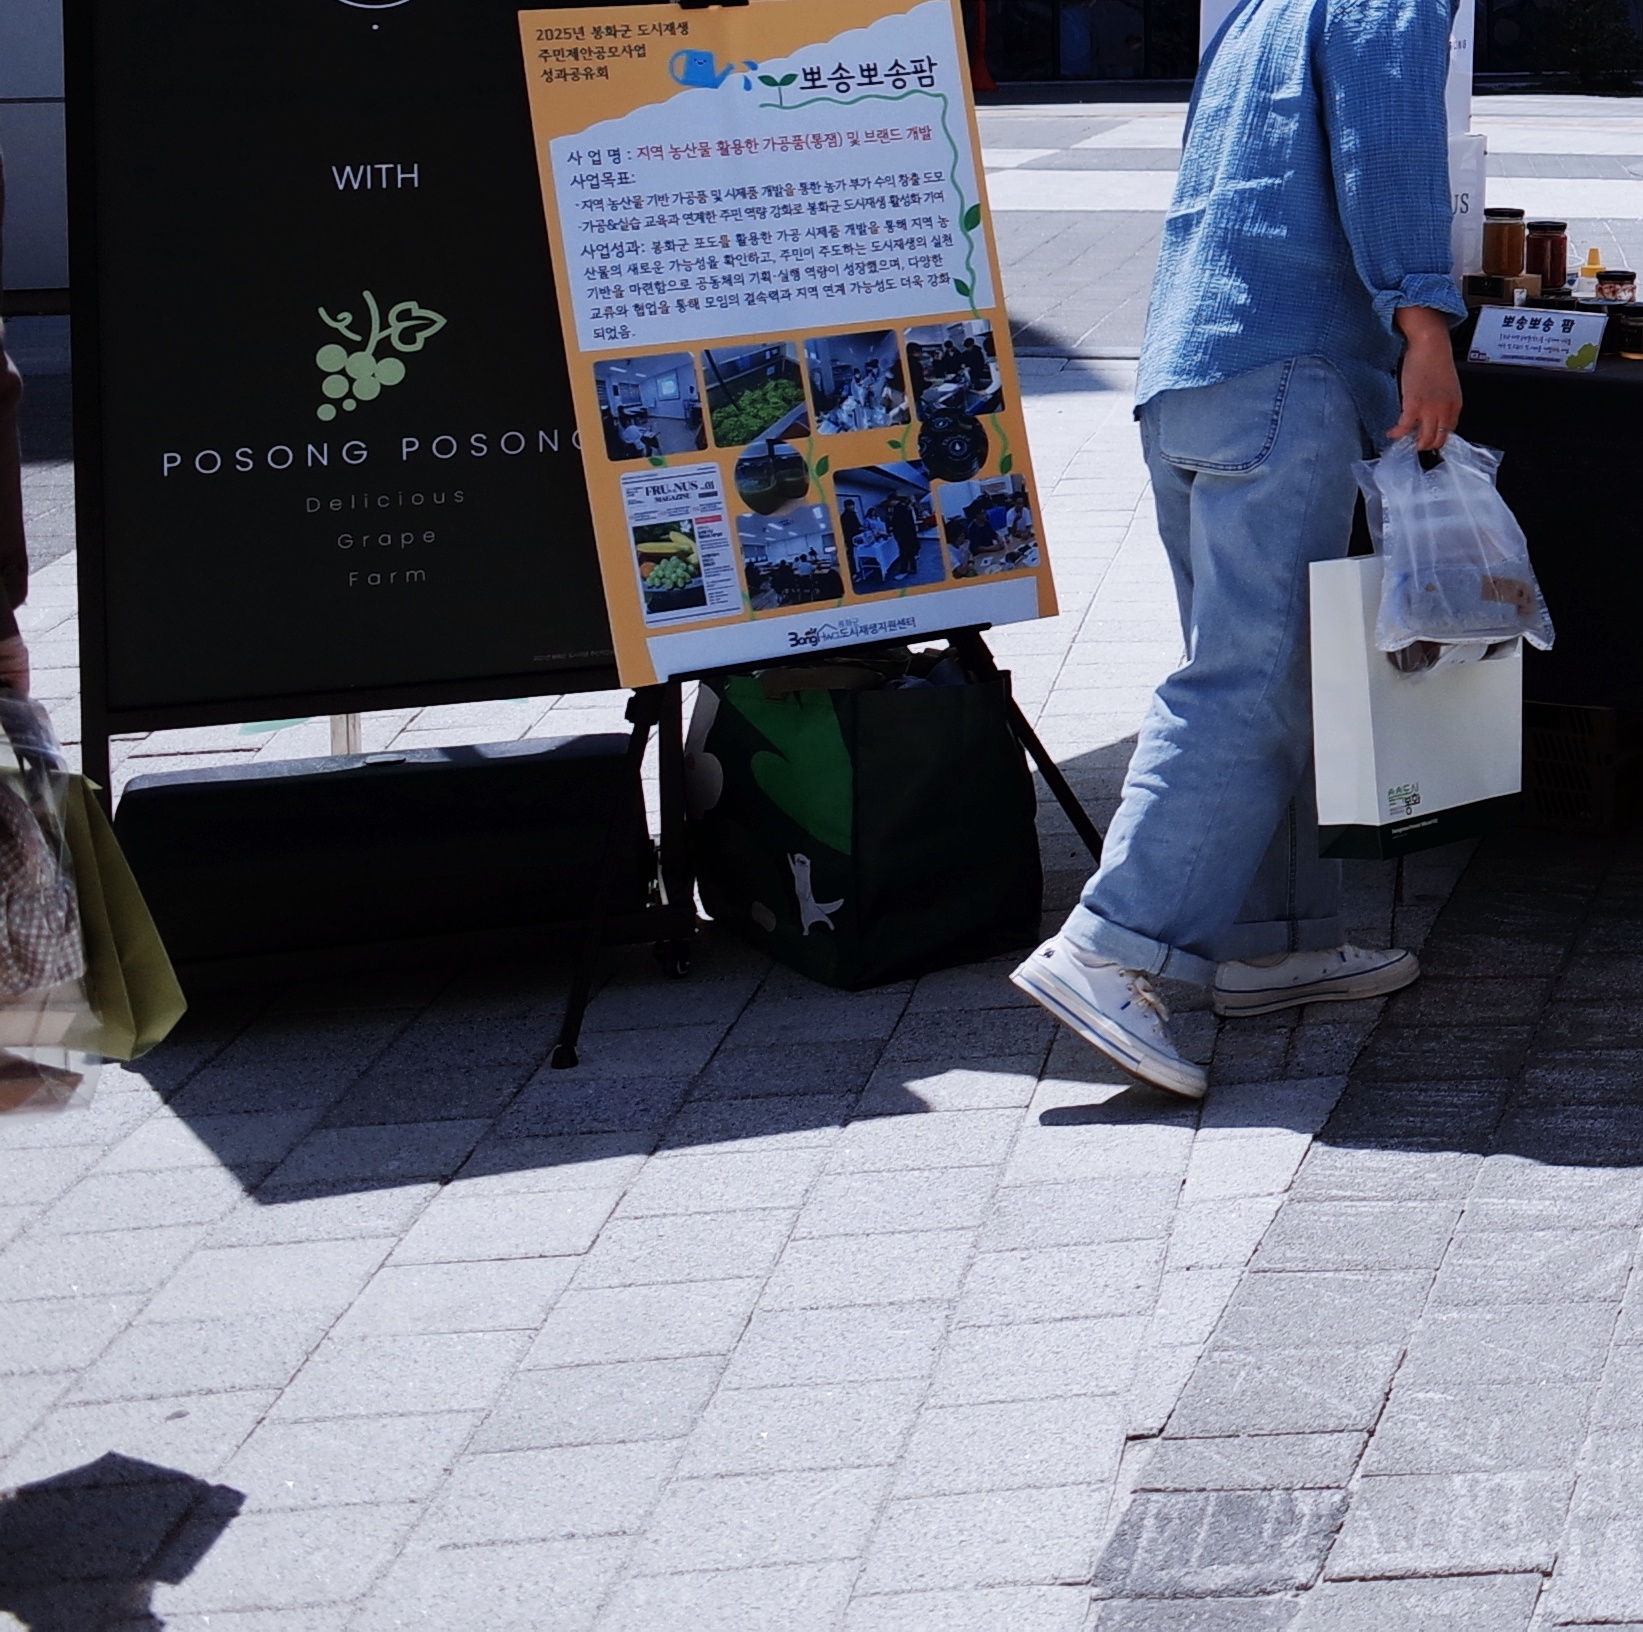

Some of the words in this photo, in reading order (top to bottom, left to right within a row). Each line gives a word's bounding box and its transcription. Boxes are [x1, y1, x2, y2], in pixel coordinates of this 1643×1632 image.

[535, 26, 585, 41] 2025년
[590, 24, 632, 40] 봉화군
[637, 21, 689, 36] 도시재생
[538, 43, 646, 62] 주민제안공모사업
[540, 65, 609, 83] 성과공유회
[796, 56, 937, 93] 뽀송뽀송팜
[636, 145, 664, 160] 지역
[668, 141, 712, 160] 농산물
[715, 138, 759, 156] 활용한
[846, 130, 860, 147] 및
[863, 128, 903, 144] 브랜드
[905, 125, 932, 141] 개발
[332, 164, 420, 191] WITH
[570, 171, 636, 189] 사업목표:
[1502, 314, 1555, 333] 뽀송뽀송
[1560, 318, 1576, 333] 팜
[163, 440, 370, 477] POSONG
[306, 487, 466, 514] Delicious
[337, 528, 437, 551] Grape
[349, 567, 427, 588] Farm
[838, 616, 916, 639] 도시재생지원센터
